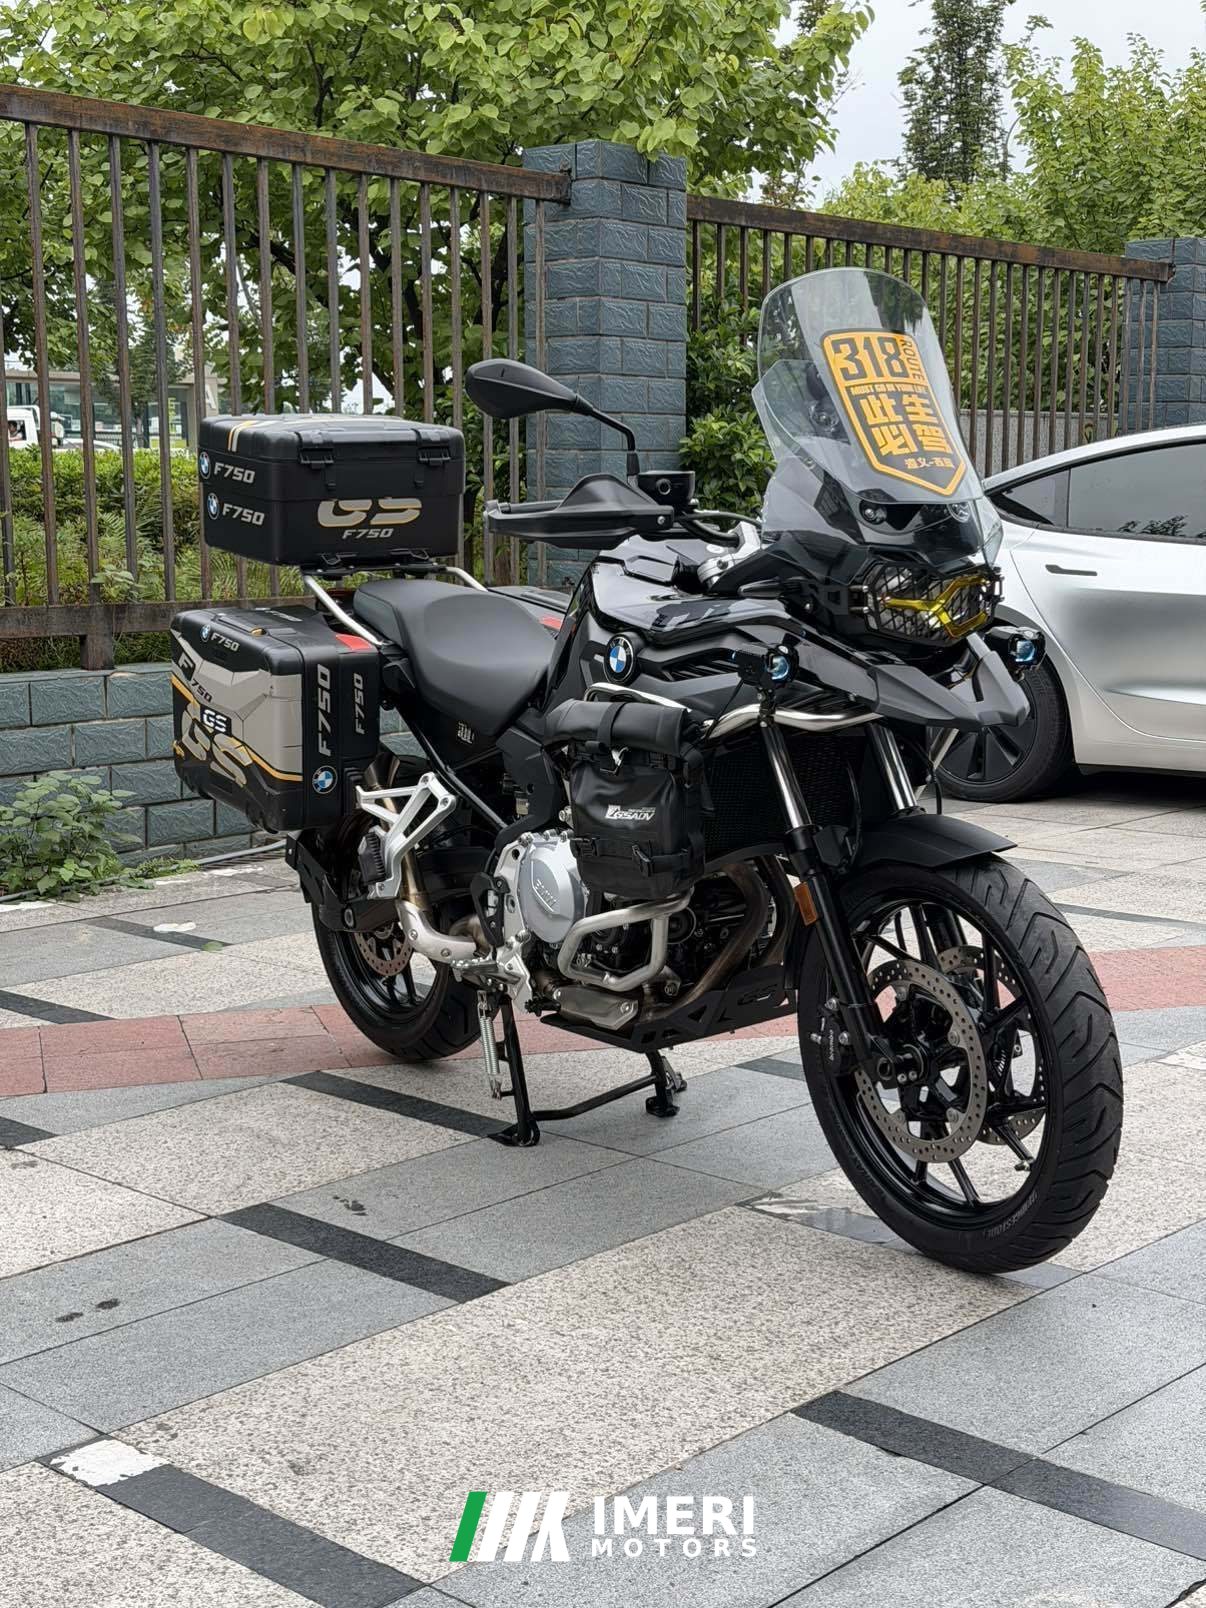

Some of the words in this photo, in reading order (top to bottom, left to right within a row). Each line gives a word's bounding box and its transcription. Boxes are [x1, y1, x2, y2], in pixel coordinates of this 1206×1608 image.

[831, 336, 909, 381] 318
[900, 336, 925, 381] ROUTE
[859, 393, 939, 425] 此生
[214, 462, 255, 484] F750
[222, 503, 265, 526] F750
[317, 497, 422, 528] GS
[342, 528, 394, 540] F750
[210, 633, 241, 652] F750
[191, 679, 213, 703] 750
[353, 672, 366, 735] F750
[202, 708, 228, 733] GS
[317, 663, 332, 757] F750
